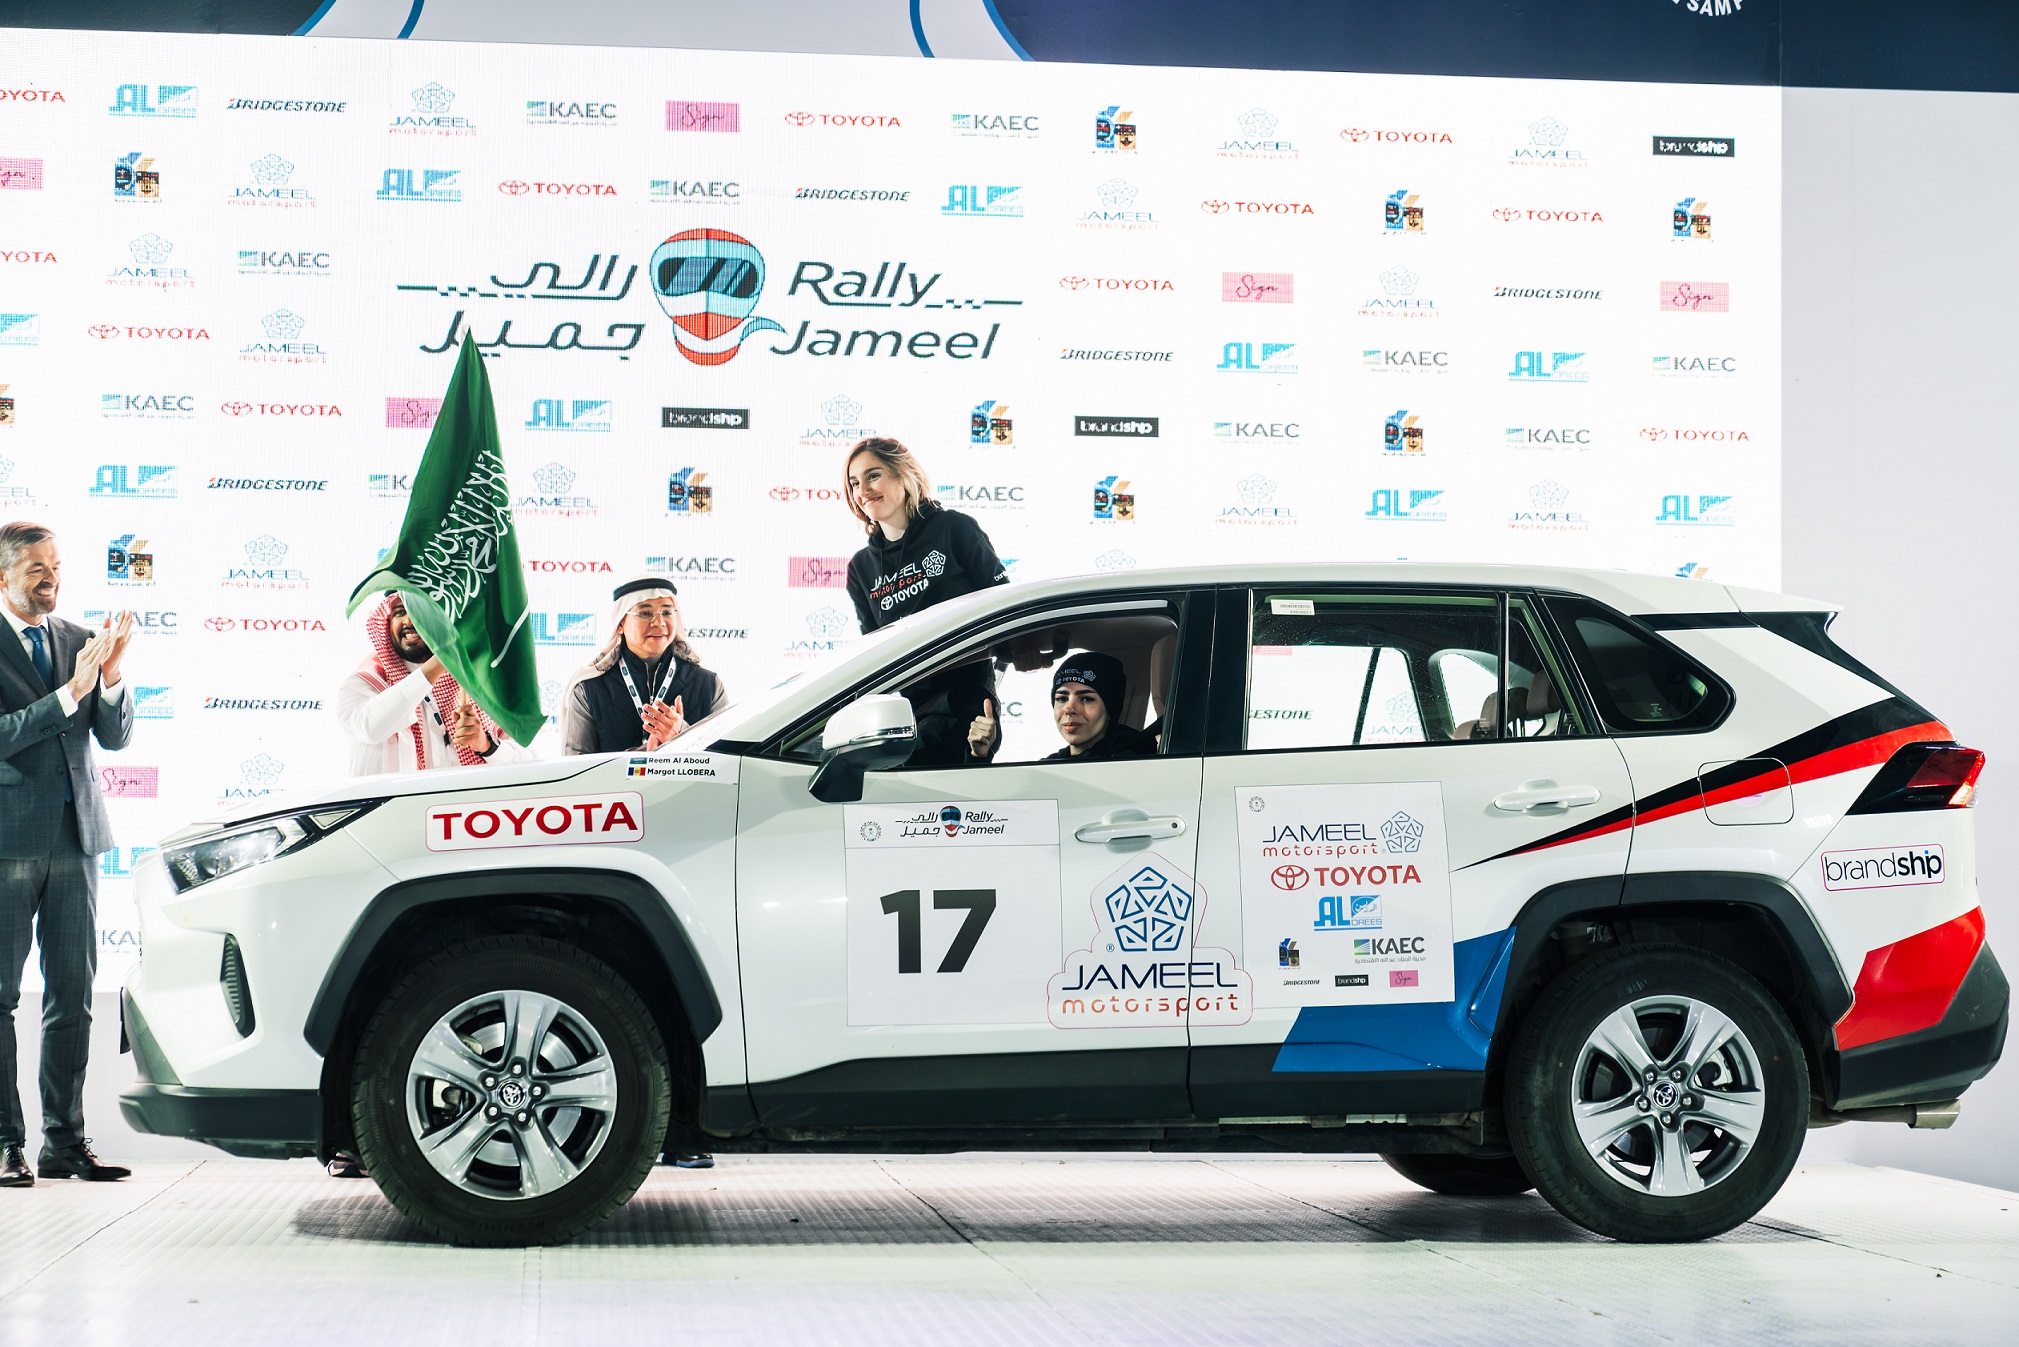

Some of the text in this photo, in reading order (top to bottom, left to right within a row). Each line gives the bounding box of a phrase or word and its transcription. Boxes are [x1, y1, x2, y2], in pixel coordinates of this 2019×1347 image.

[0, 89, 65, 102] OYOTA
[550, 101, 617, 118] KAEC
[820, 114, 901, 127] TOYOTA
[974, 114, 1039, 131] KAEC
[1373, 131, 1453, 143] TOYOTA
[533, 182, 617, 196] TOYOTA
[673, 181, 739, 197] KAEC
[1235, 202, 1315, 214] TOYOTA
[1526, 210, 1604, 223] TOYOTA
[0, 251, 57, 263] YOTA
[261, 251, 330, 268] KAEC
[787, 261, 943, 307] Rally
[1093, 278, 1174, 291] TOYOTA
[124, 327, 211, 339] TOYOTA
[769, 320, 1000, 360] Jameel
[1385, 350, 1448, 366] KAEC
[1674, 357, 1736, 372] KAEC
[125, 395, 194, 411] KAEC
[257, 404, 342, 416] TOYOTA
[1235, 423, 1300, 438] KAEC
[1527, 428, 1590, 444] KAEC
[1674, 429, 1750, 442] TOYOTA
[805, 489, 842, 500] TOY
[959, 486, 1024, 501] KAEC
[529, 560, 613, 574] TOYOTA
[669, 557, 735, 573] KAEC
[893, 578, 930, 604] TOYOTA
[240, 618, 325, 632] TOYOTA
[686, 628, 749, 641] ESTONE
[1249, 709, 1313, 720] ESTONE
[647, 768, 716, 777] Margot LLOBERA
[432, 801, 639, 841] TOYOTA
[965, 811, 994, 823] Rally
[900, 826, 941, 838] جميل
[962, 824, 1005, 835] Jameel
[1263, 823, 1377, 844] JAMEEL
[1263, 842, 1378, 859] motorsport
[1314, 864, 1422, 887] TOYOTA
[880, 888, 997, 974] 17
[1371, 936, 1425, 955] KAEC
[1062, 962, 1238, 991] JAMEEL
[1062, 993, 1239, 1018] motorsport
